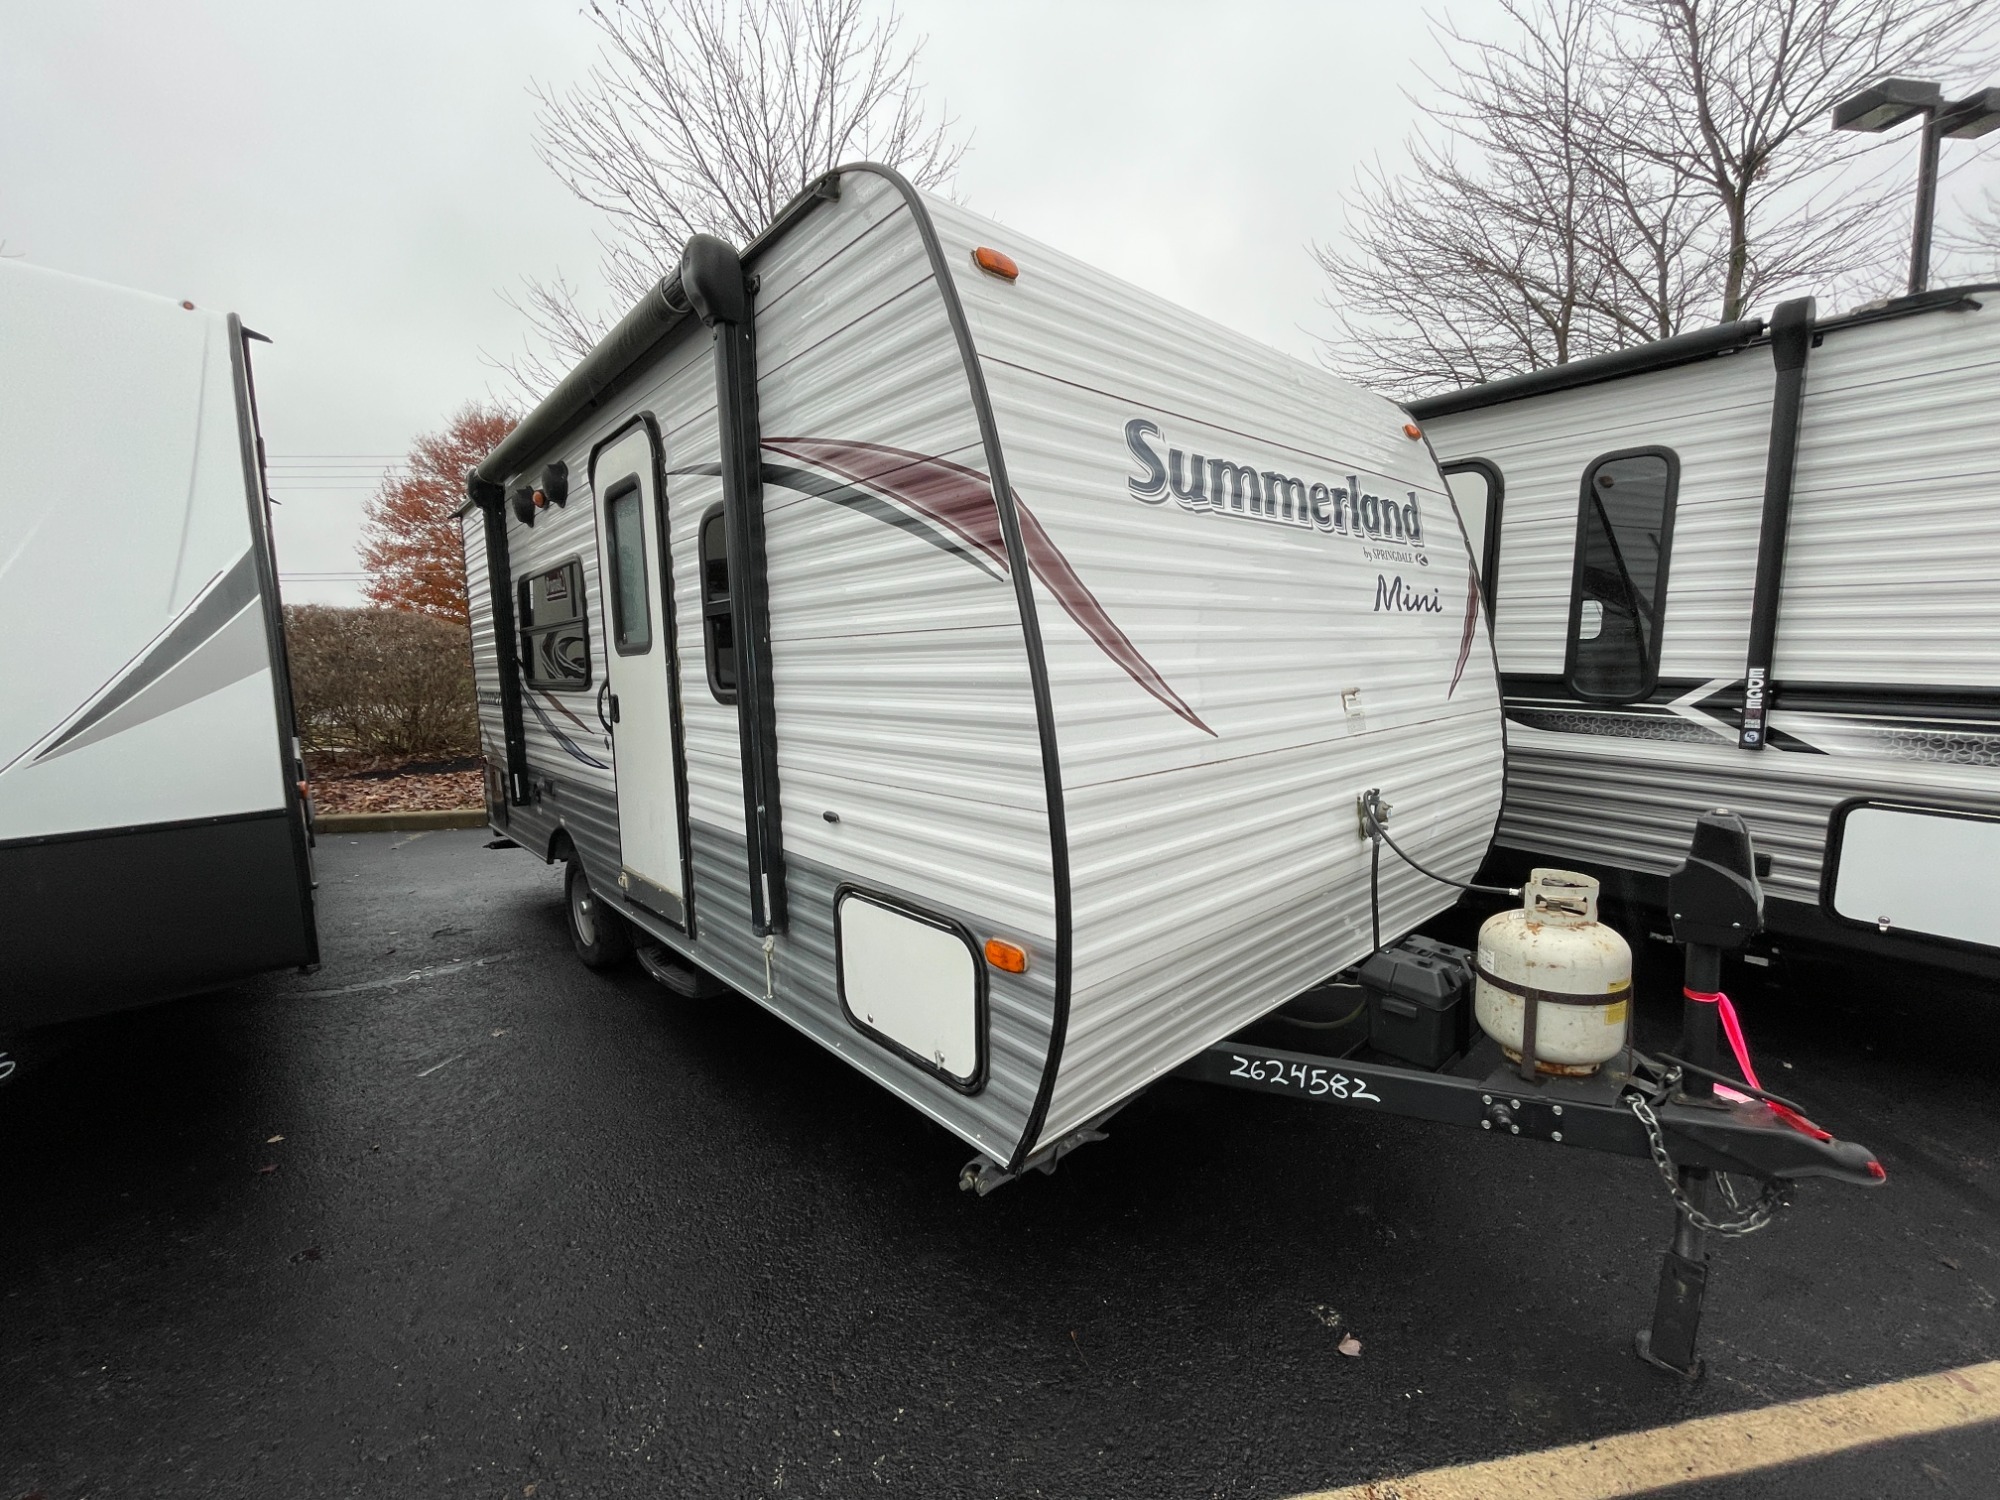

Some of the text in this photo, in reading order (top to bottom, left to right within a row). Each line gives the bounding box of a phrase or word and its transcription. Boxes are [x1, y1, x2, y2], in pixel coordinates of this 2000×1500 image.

[1124, 418, 1424, 547] Summerland
[1362, 546, 1414, 563] by SPRINGDALE
[1374, 574, 1443, 613] Mini
[1746, 668, 1765, 709] EDGE
[1229, 1055, 1381, 1102] 2624582
